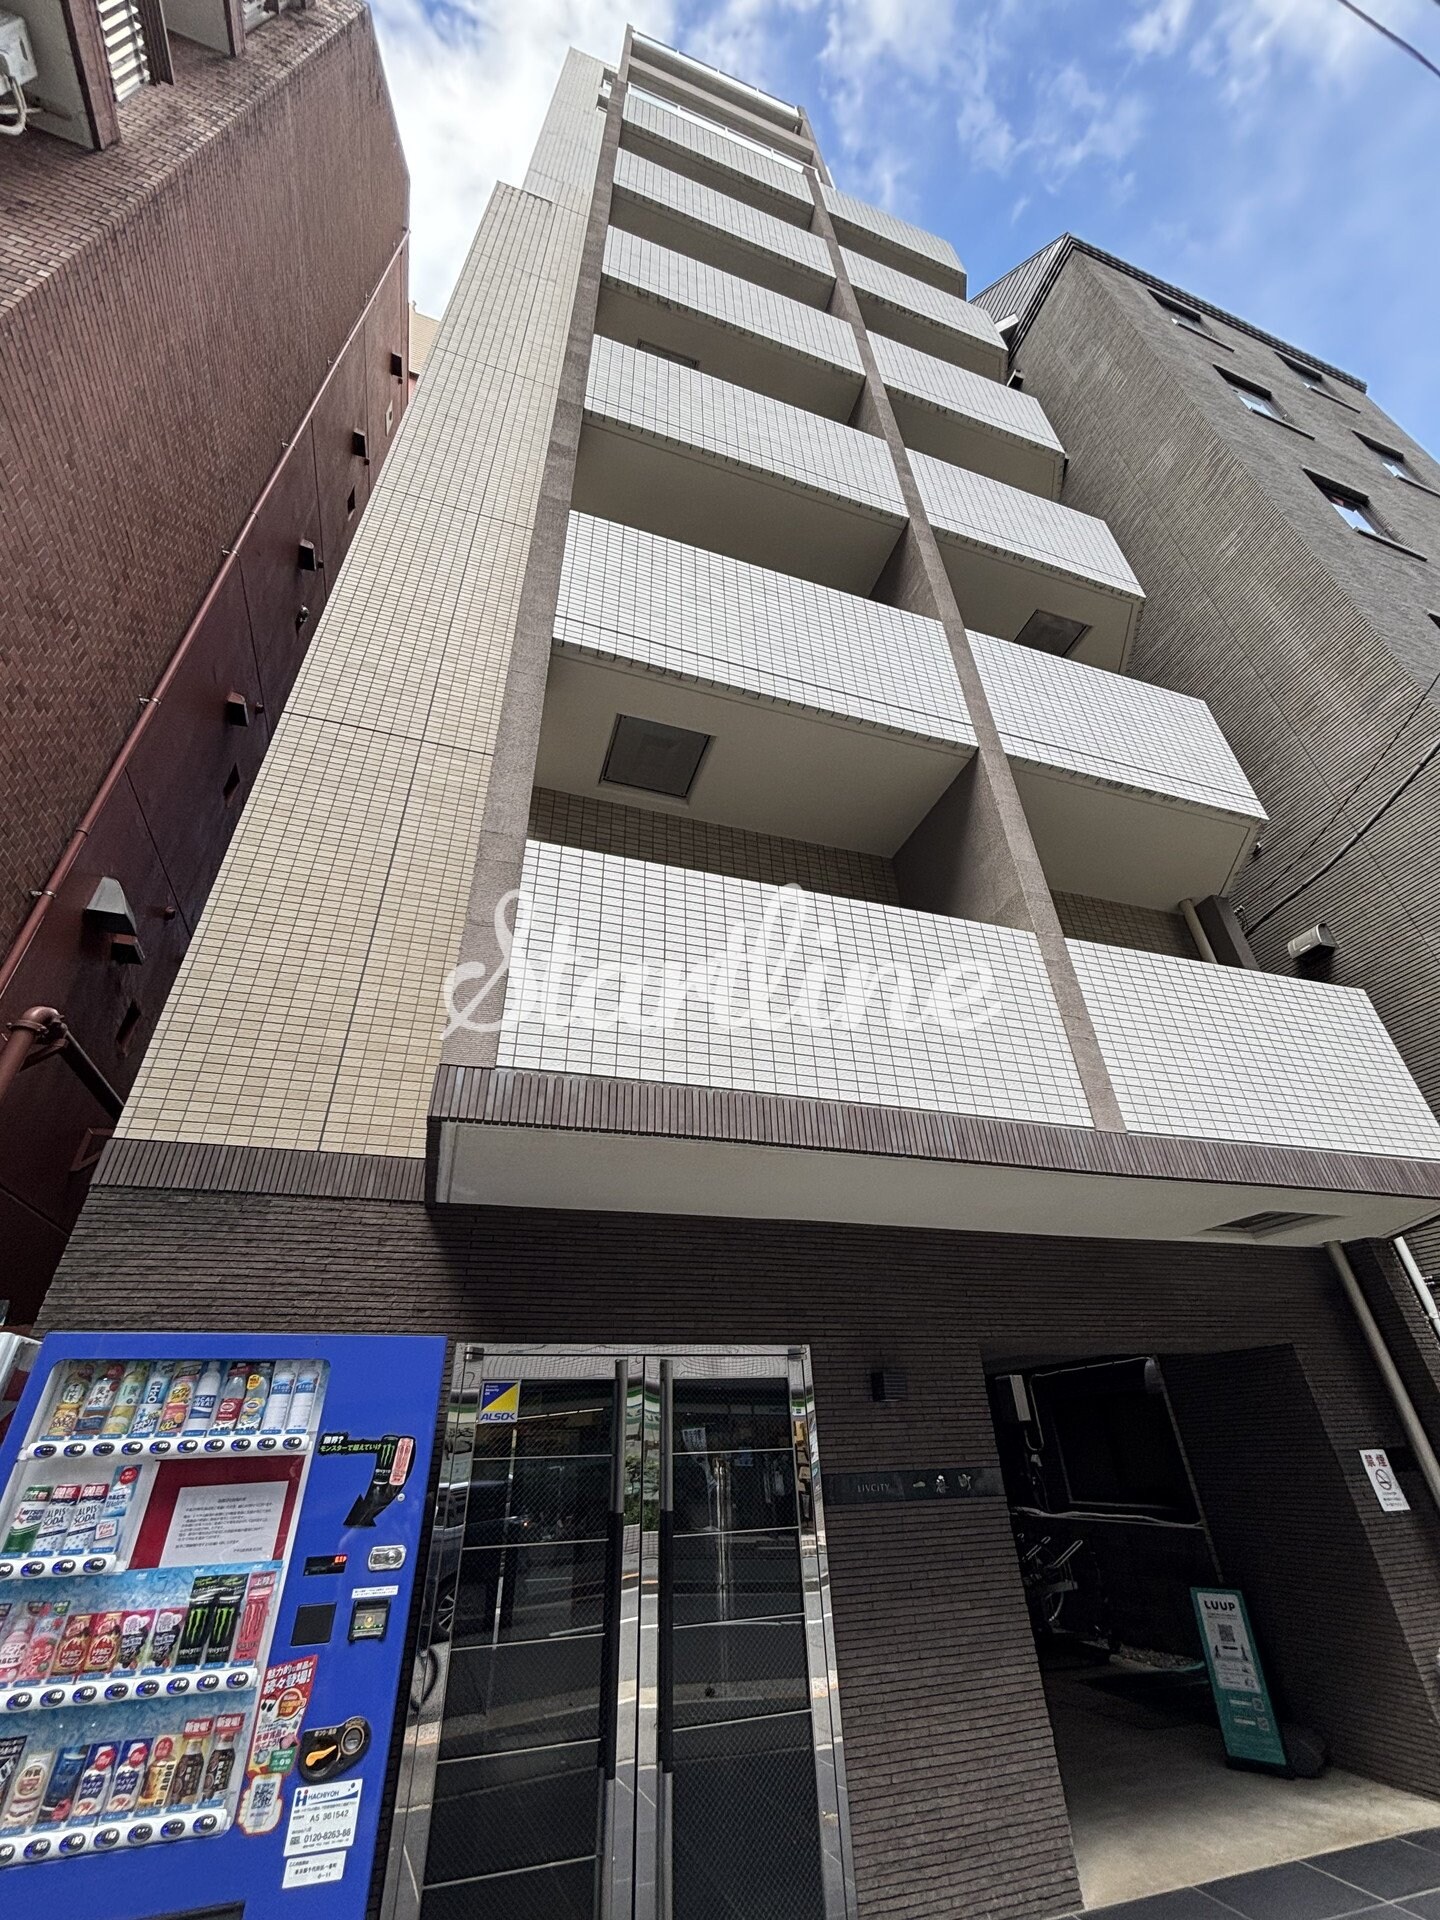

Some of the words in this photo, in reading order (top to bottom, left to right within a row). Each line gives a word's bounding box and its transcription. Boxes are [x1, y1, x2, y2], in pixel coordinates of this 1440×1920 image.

[480, 1412, 516, 1421] ALSOK
[320, 1443, 382, 1452] モンスターで超えていけ
[1364, 1453, 1388, 1468] 禁煙
[857, 1483, 890, 1493] LIVCITY
[1204, 1600, 1236, 1612] LUUP
[308, 1790, 340, 1801] HACHIYOH
[309, 1814, 320, 1823] AS
